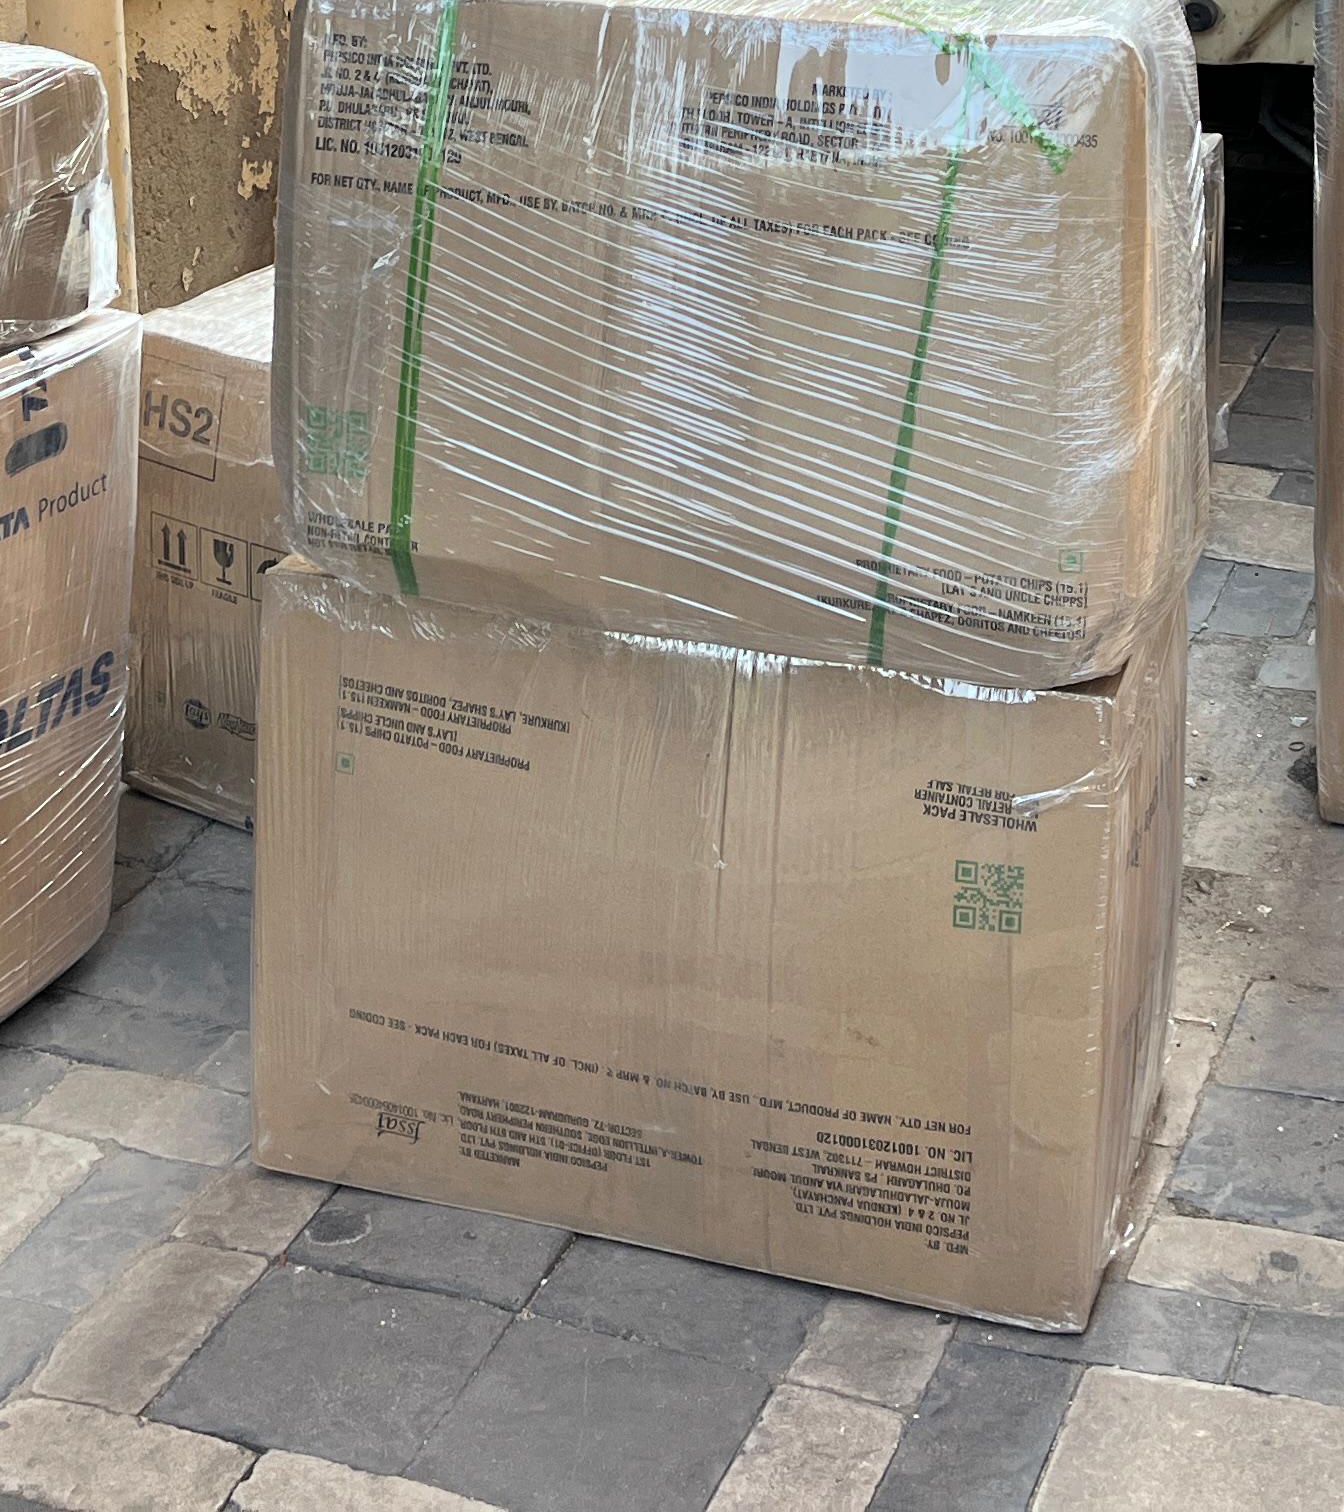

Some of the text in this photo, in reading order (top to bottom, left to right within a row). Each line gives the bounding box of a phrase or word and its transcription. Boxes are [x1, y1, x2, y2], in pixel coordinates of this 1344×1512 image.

[317, 115, 361, 132] DISTRICT
[314, 136, 360, 154] LIC. NO.
[310, 172, 331, 186] FOR
[333, 175, 354, 189] NET
[383, 179, 412, 194] NAME
[856, 226, 886, 242] PACK
[143, 390, 214, 445] HS2
[38, 474, 108, 523] Product
[1020, 576, 1053, 592] CHIPS
[1005, 589, 1041, 604] UNCLE
[957, 615, 1005, 632] DORITOS
[384, 683, 405, 698] AND
[405, 687, 447, 707] DORITOS
[365, 693, 512, 735] PROPRIETARY FOOD NAMKEEN
[373, 713, 404, 730] UNCLE
[488, 705, 516, 722] LAY'S
[364, 725, 392, 740] CHIPS
[405, 720, 425, 735] AND
[392, 731, 429, 748] POTATO
[437, 741, 464, 756] FOOD
[465, 747, 530, 770] PROPRIETARY
[912, 787, 973, 808] CONTAINER
[921, 803, 1038, 832] WHOLESALE PACK
[347, 1006, 386, 1025] CODING
[386, 1016, 406, 1031] SEE
[412, 1021, 441, 1039] PACK
[440, 1028, 469, 1046] EACH
[469, 1035, 491, 1051] FOR
[492, 1039, 530, 1059] TAXES)
[530, 1048, 550, 1063] ALL
[551, 1053, 566, 1067] OF
[615, 1069, 639, 1082] MRP
[641, 1074, 649, 1084] &
[672, 1080, 707, 1096] BATCH
[727, 1091, 750, 1104] USE
[784, 1099, 839, 1119] PRODUCT,
[841, 1107, 857, 1120] OF
[858, 1109, 892, 1125] NAME
[923, 1118, 946, 1132] NET
[947, 1121, 971, 1136] FOR
[507, 1128, 527, 1141] AND
[497, 1140, 542, 1158] HOLDINGS
[748, 1138, 789, 1155] BENGAL
[791, 1145, 821, 1160] WEST
[922, 1145, 946, 1160] NO.
[473, 1148, 520, 1167] MARKETED
[543, 1150, 568, 1163] INDIA
[569, 1155, 608, 1171] PEPSICO
[602, 1148, 633, 1163] FLOOR
[948, 1148, 973, 1164] LIC.
[874, 1157, 921, 1175] HOWRAH
[923, 1164, 971, 1183] DISTRICT
[789, 1172, 823, 1187] ANDUL
[863, 1169, 878, 1182] PS
[825, 1178, 843, 1191] VIA
[838, 1208, 892, 1228] HOLDINGS
[906, 1205, 914, 1216] 4
[916, 1207, 925, 1218] &
[927, 1209, 934, 1220] 2
[893, 1218, 923, 1233] INDIA
[924, 1223, 970, 1241] PEPSICO
